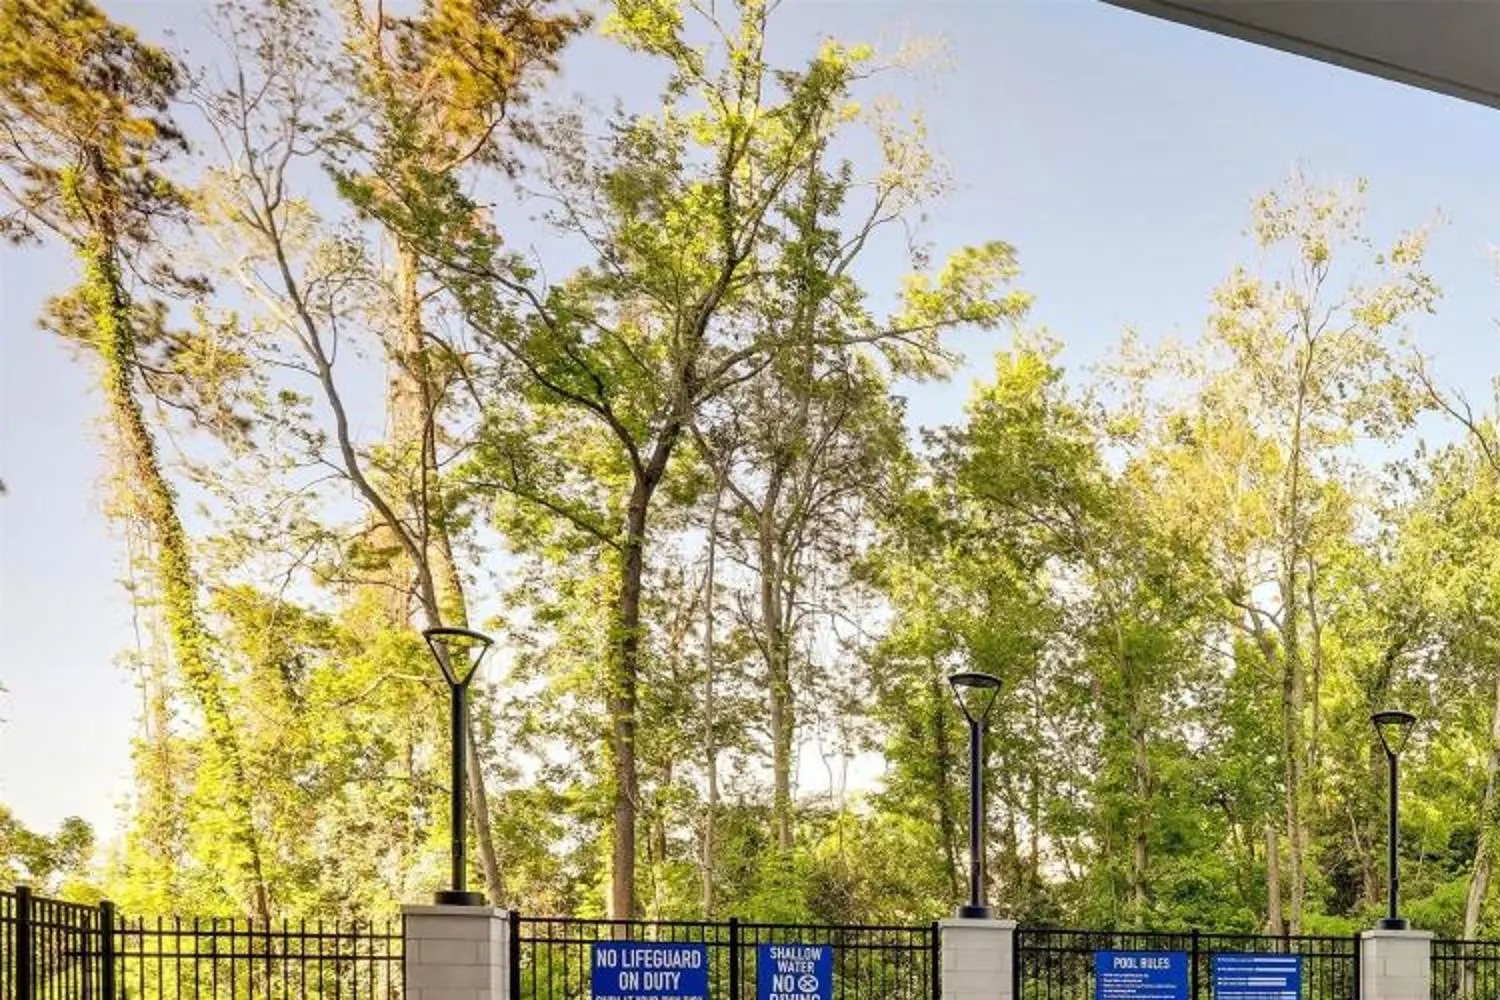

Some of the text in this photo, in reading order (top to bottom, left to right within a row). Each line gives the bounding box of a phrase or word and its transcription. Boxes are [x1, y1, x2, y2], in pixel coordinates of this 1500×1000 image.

[597, 948, 701, 968] NO LIFEGUARD
[769, 946, 822, 960] SHALLOW
[777, 961, 815, 973] WATER
[1113, 957, 1170, 969] POOL RULES
[619, 971, 680, 991] ON DUTY
[773, 975, 795, 992] NO
